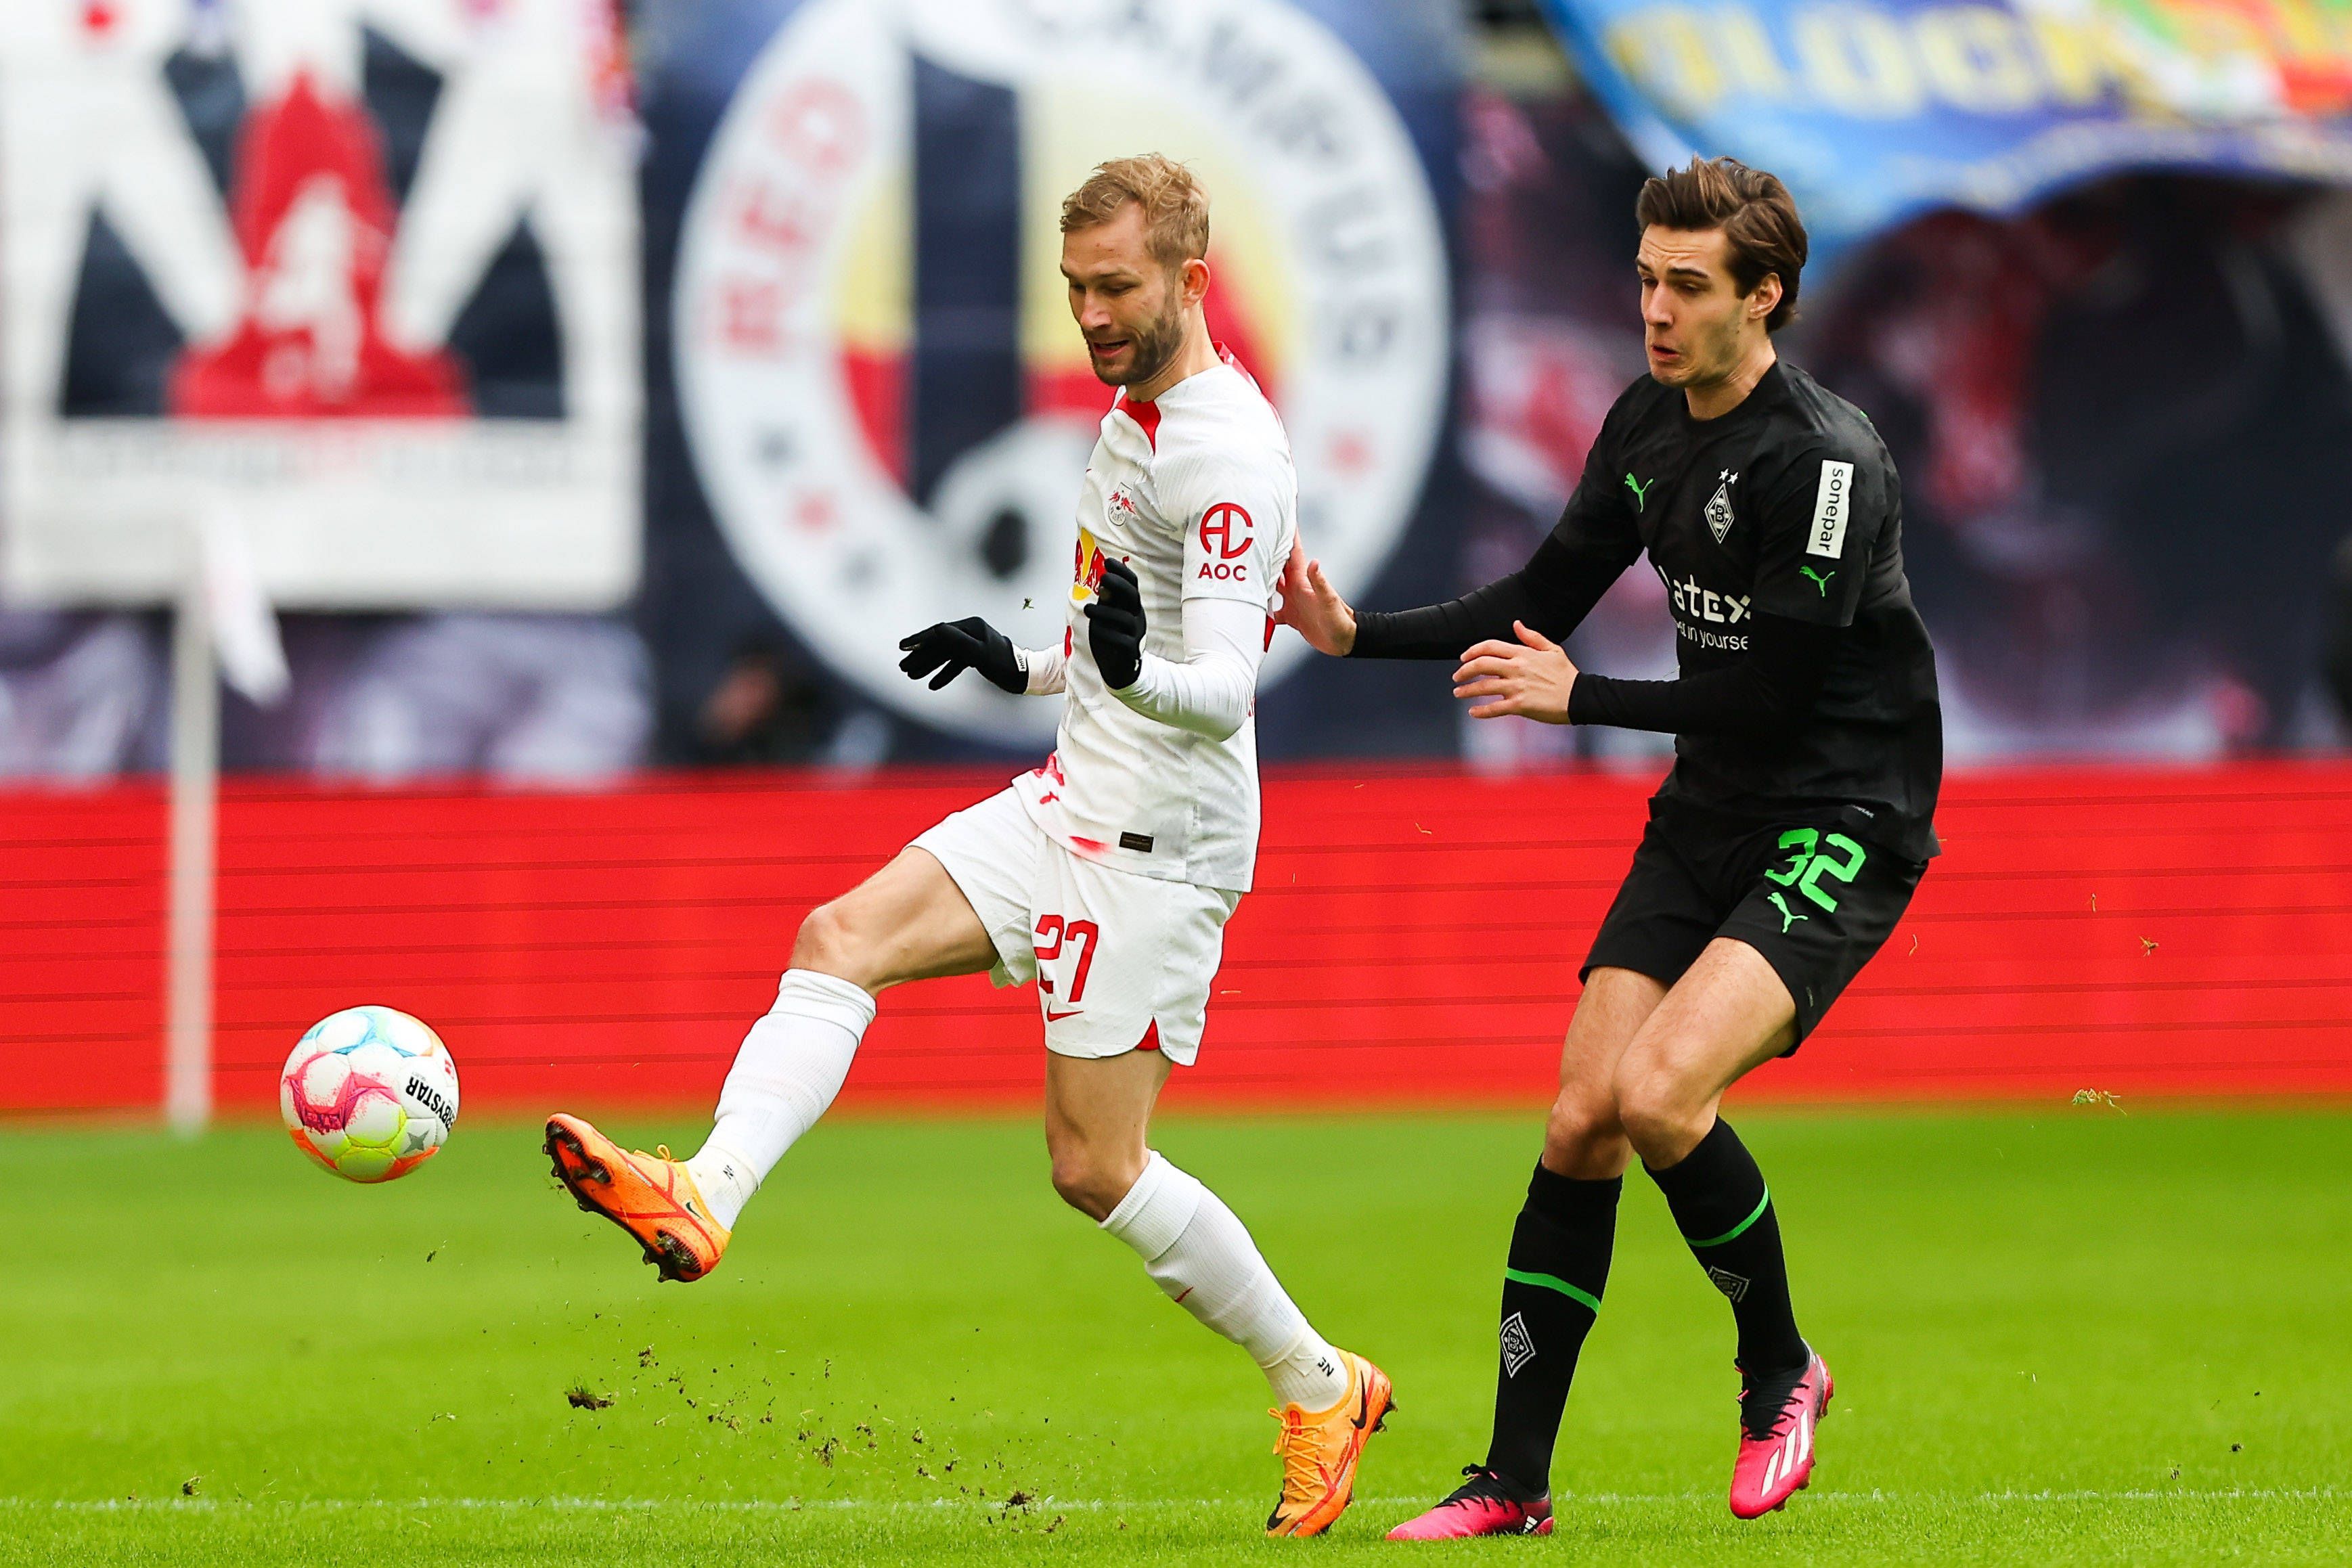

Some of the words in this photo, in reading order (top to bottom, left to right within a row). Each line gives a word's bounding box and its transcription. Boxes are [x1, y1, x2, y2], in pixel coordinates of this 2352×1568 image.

[1819, 468, 1844, 552] sonepar
[1197, 563, 1247, 581] AOC
[1700, 629, 1748, 650] yourse
[1765, 828, 1866, 914] 32
[1034, 914, 1099, 1003] 27
